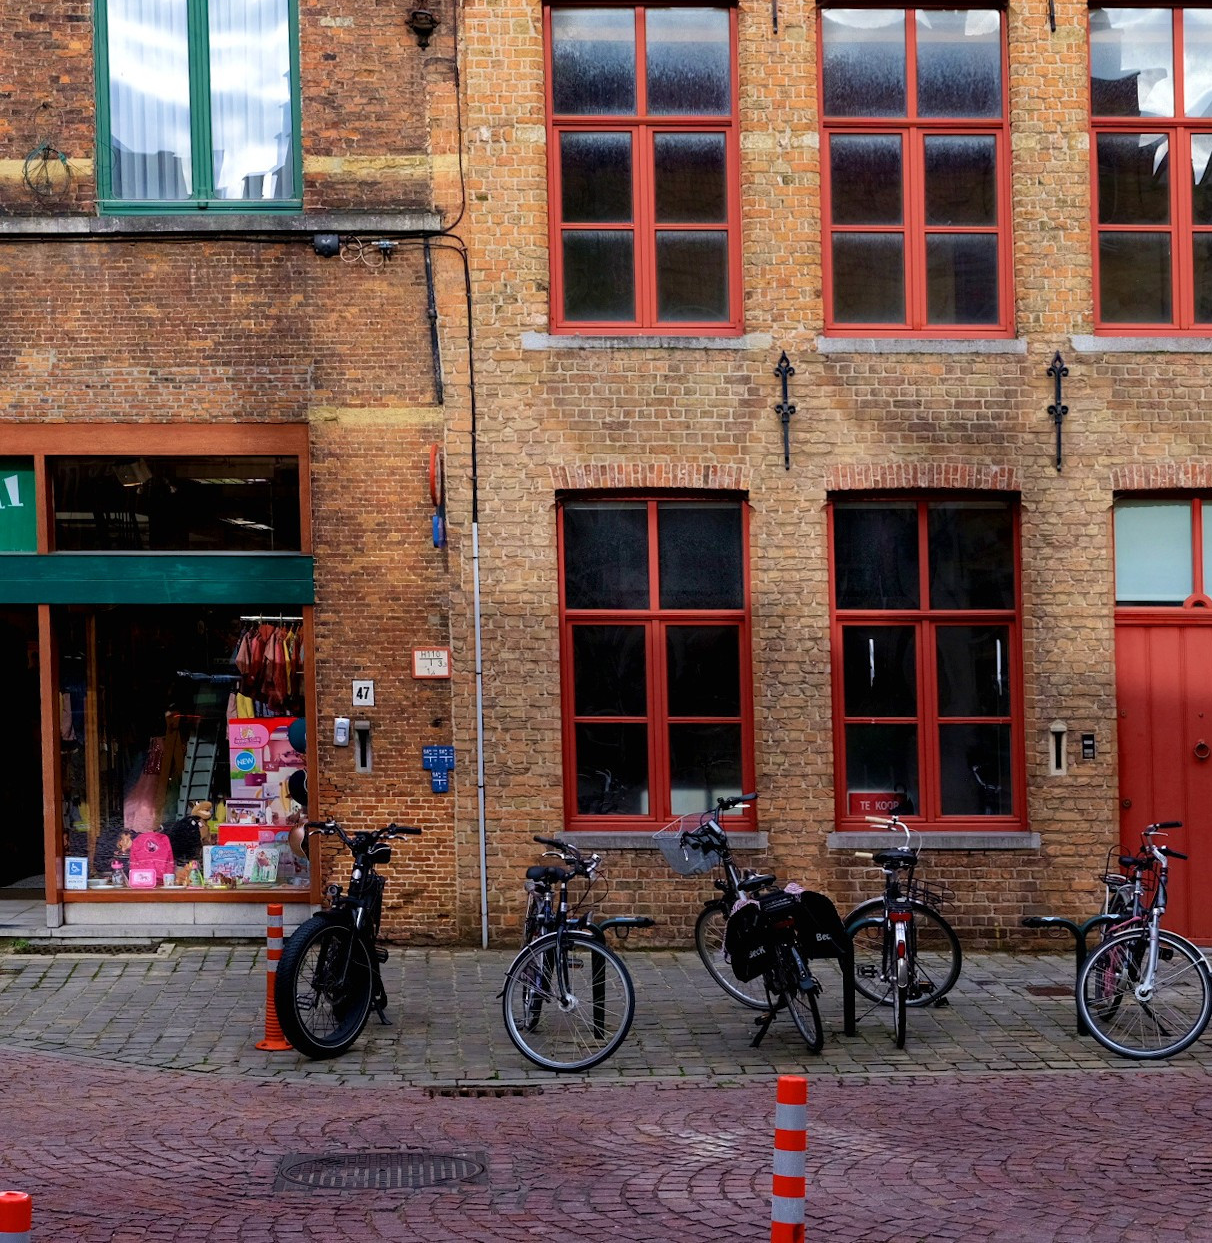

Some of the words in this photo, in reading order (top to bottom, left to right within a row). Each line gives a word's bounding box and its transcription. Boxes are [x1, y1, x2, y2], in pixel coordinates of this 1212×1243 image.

[356, 686, 370, 700] 47
[236, 757, 254, 766] NEW
[860, 800, 871, 811] TE
[875, 800, 900, 811] KOOP
[816, 932, 832, 942] Bec
